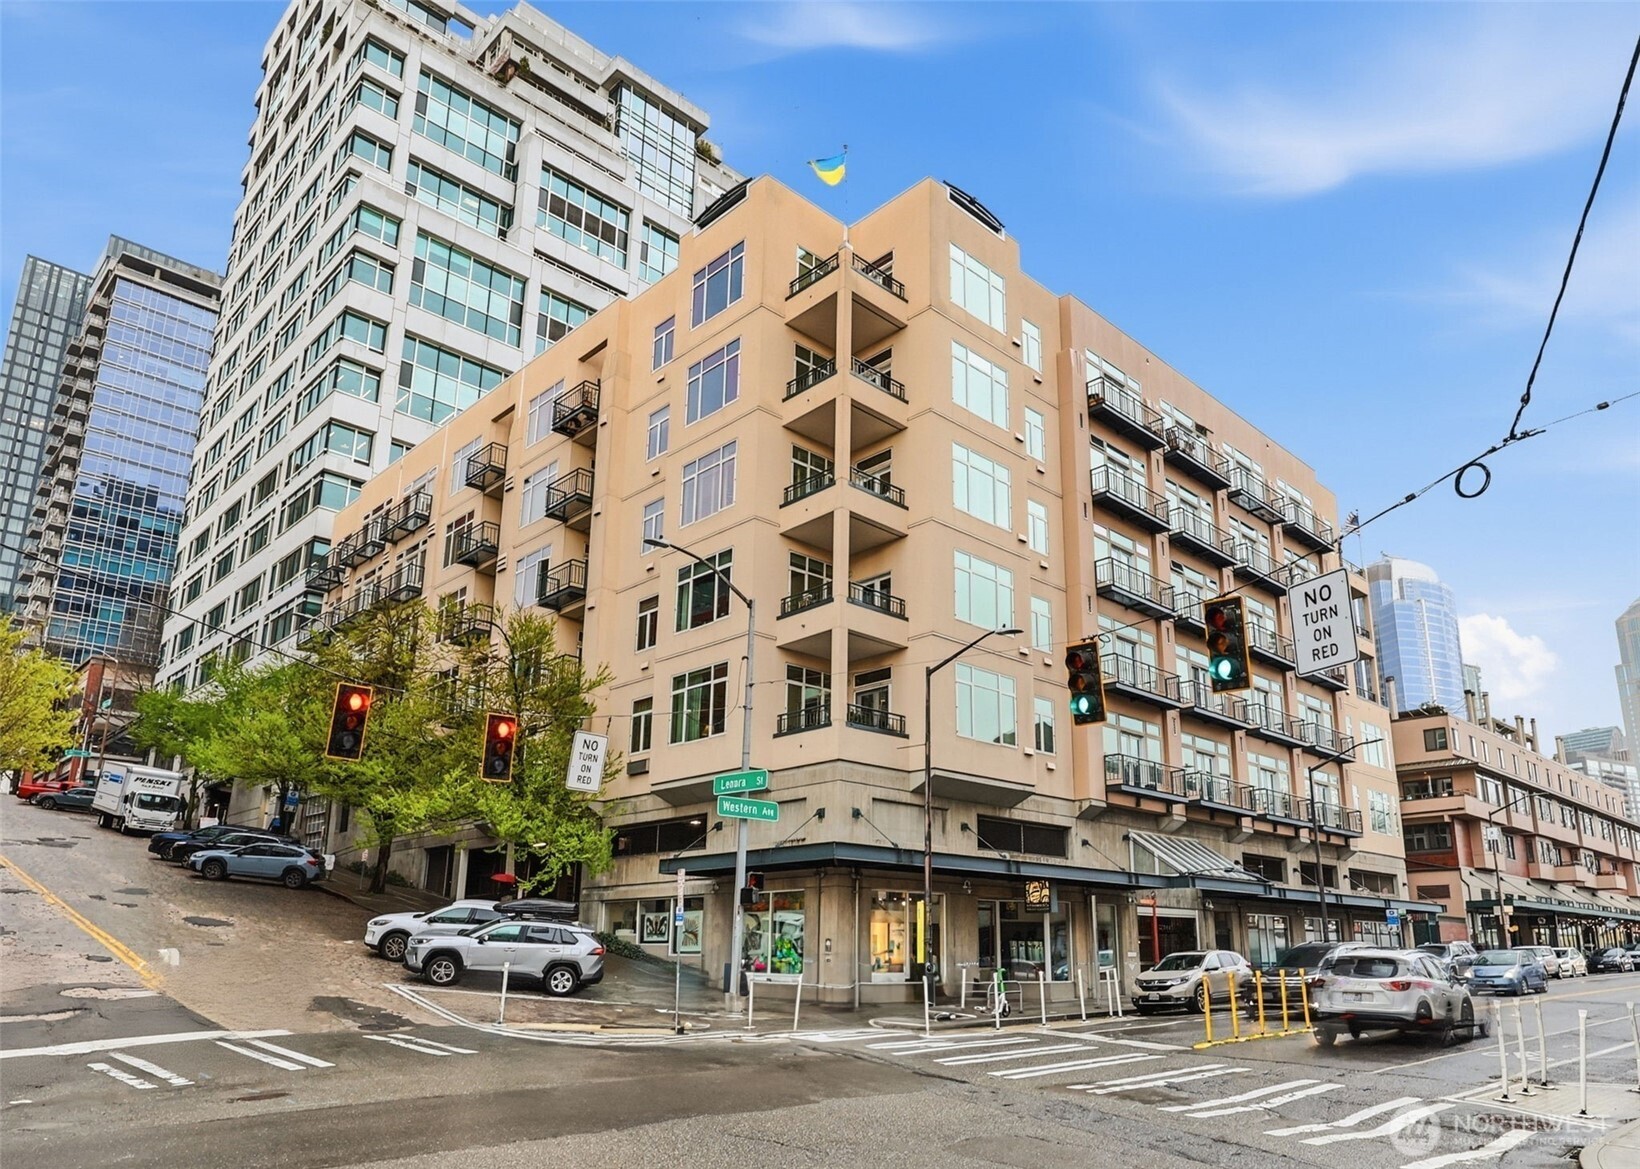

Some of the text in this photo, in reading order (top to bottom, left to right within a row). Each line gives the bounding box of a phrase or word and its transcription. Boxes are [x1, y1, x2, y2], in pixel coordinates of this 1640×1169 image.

[1304, 584, 1332, 608] NO
[1302, 604, 1338, 626] TURN
[1313, 625, 1332, 641] ON
[1312, 643, 1339, 661] RED
[583, 739, 599, 751] NO
[579, 751, 598, 763] TURN
[581, 764, 592, 773] ON
[576, 775, 592, 785] RED
[720, 776, 764, 790] Lenora St
[722, 800, 758, 815] Western
